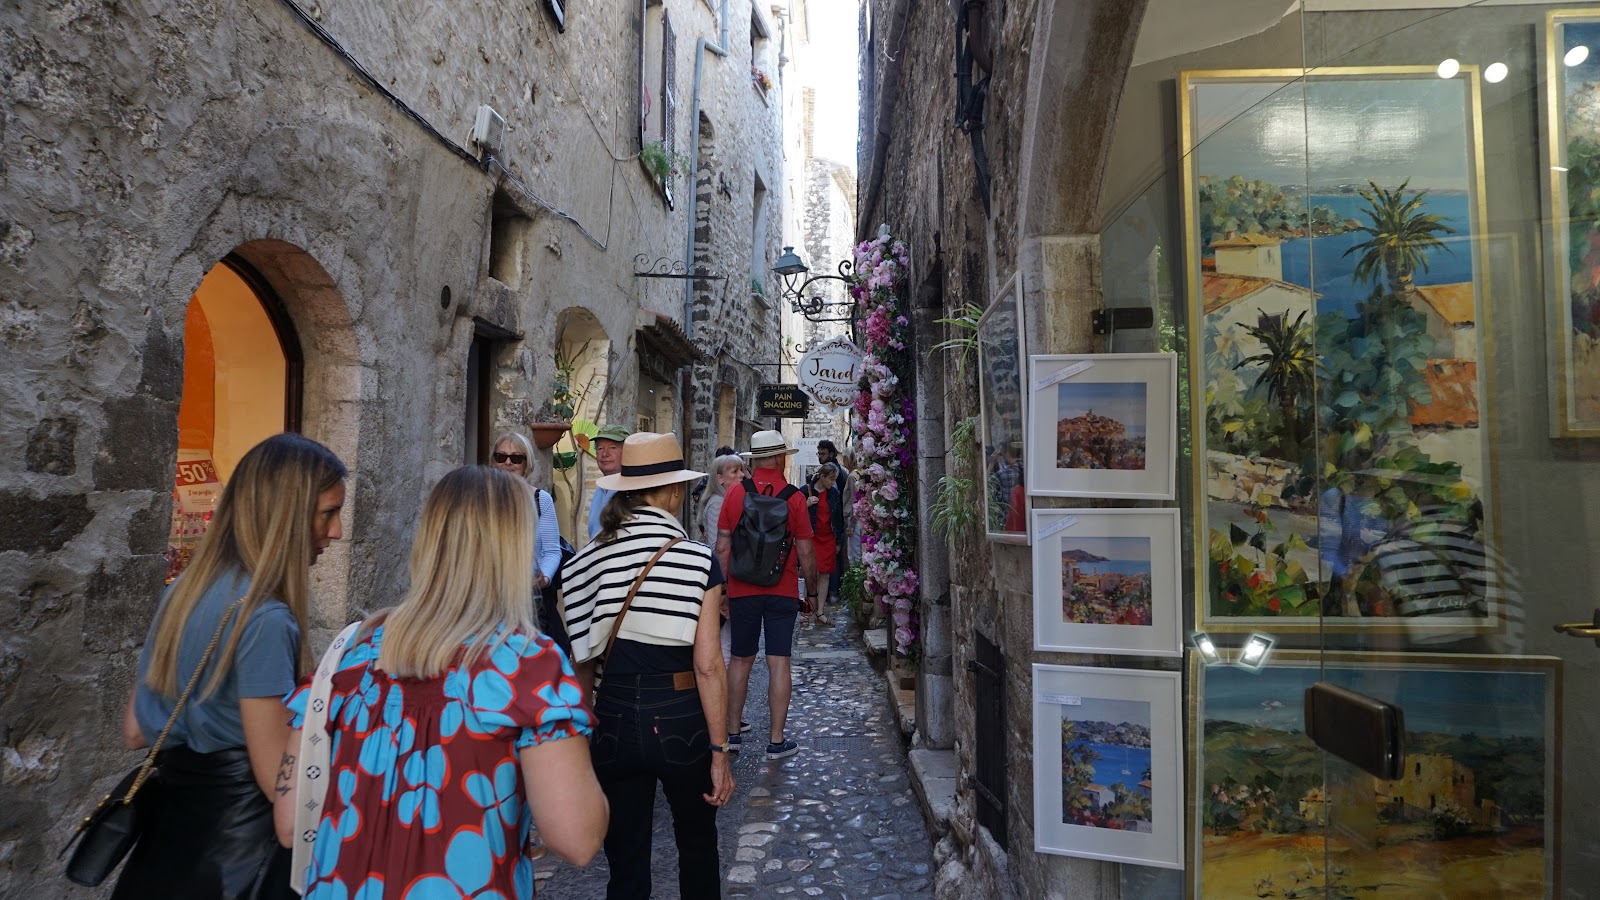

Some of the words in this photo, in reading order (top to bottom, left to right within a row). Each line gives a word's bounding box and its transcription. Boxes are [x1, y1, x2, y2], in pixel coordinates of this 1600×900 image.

[809, 358, 855, 381] Jarod
[763, 401, 802, 409] SNACKING
[176, 462, 214, 483] -50%
